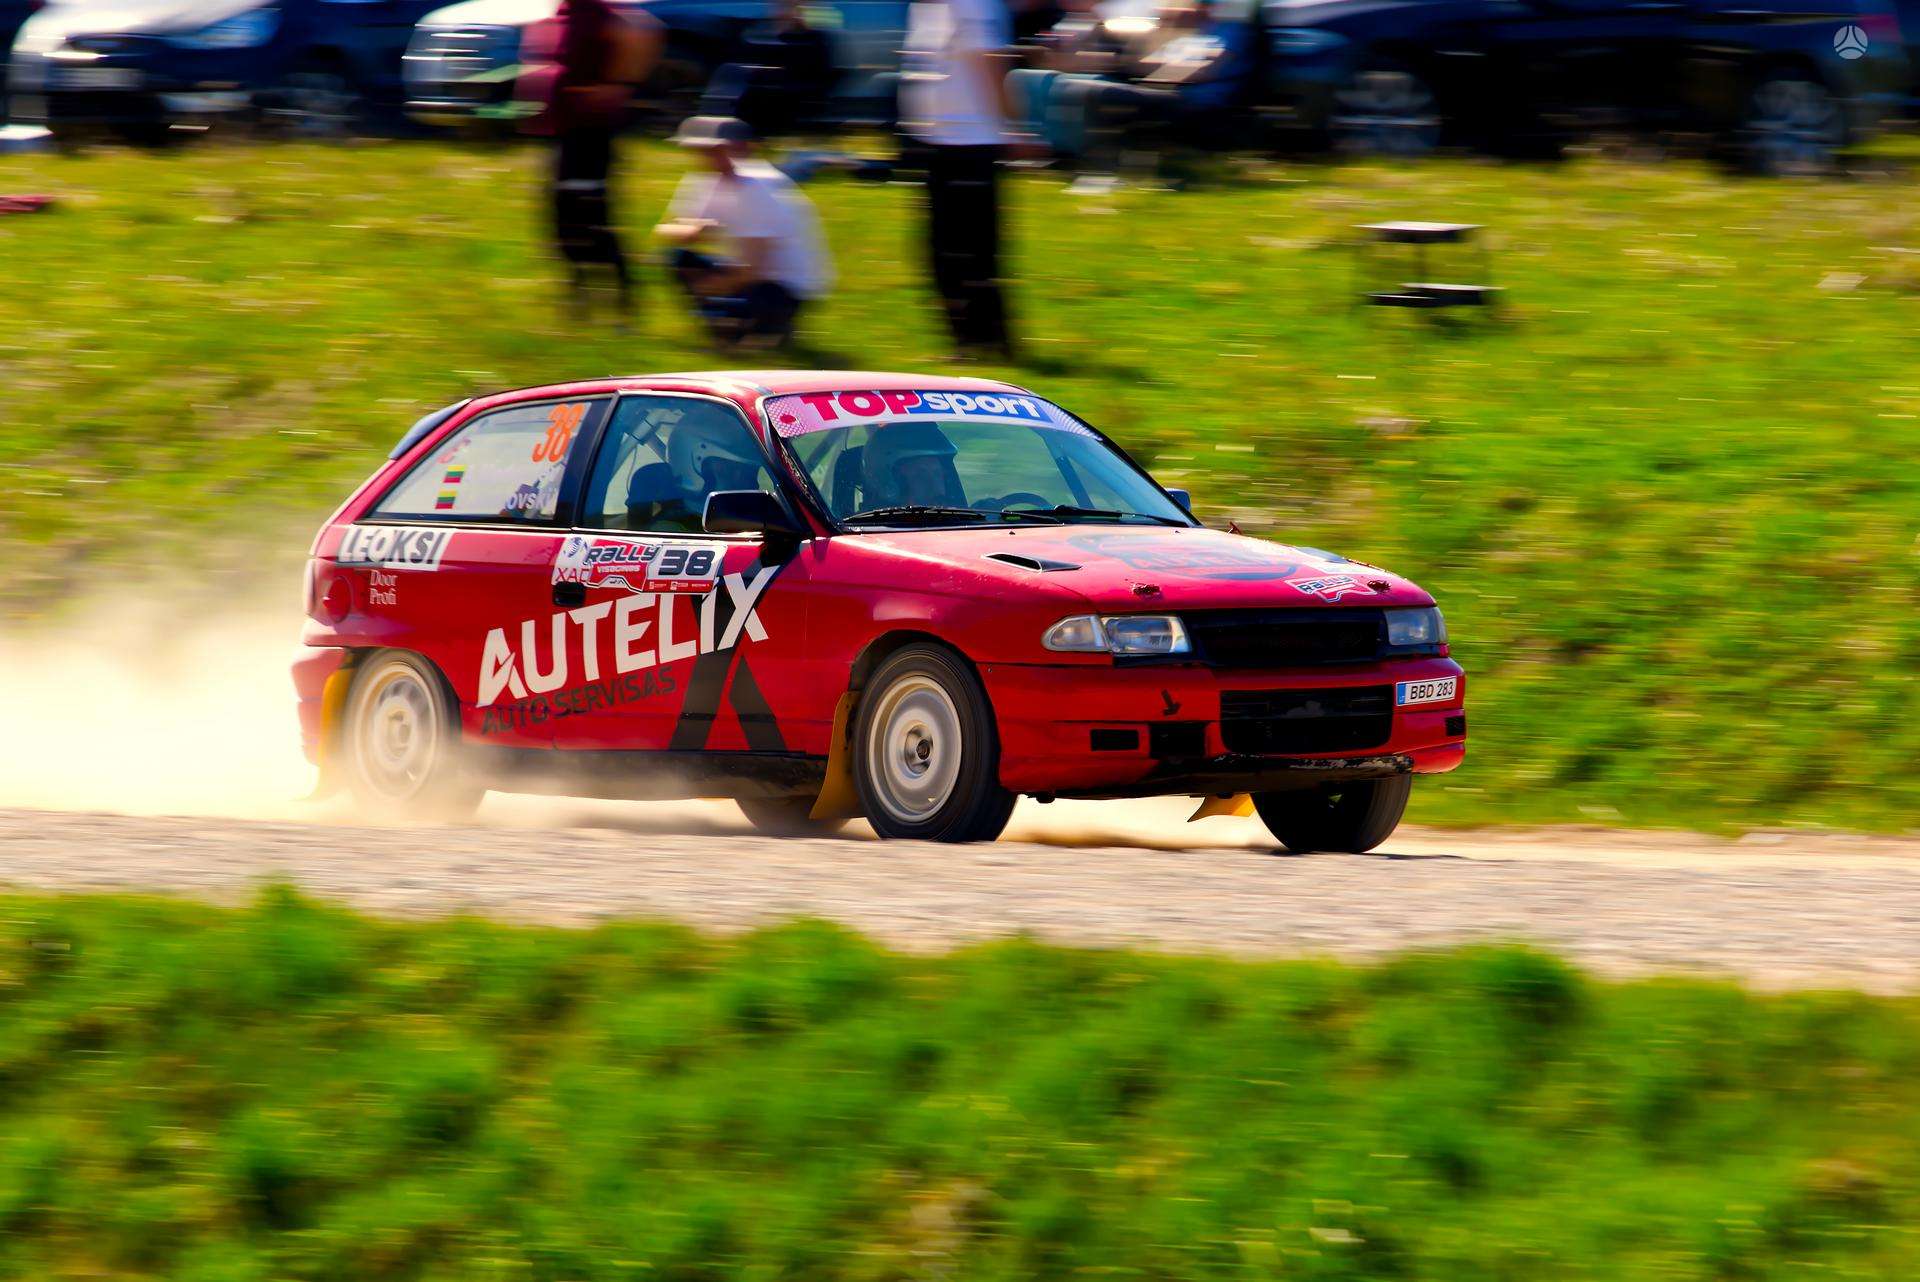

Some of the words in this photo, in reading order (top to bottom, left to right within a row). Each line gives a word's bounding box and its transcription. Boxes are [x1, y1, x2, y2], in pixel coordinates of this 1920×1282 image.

[657, 549, 716, 576] 38
[476, 566, 781, 707] AUTELIX
[1410, 684, 1434, 700] BBD
[1437, 681, 1454, 697] 283
